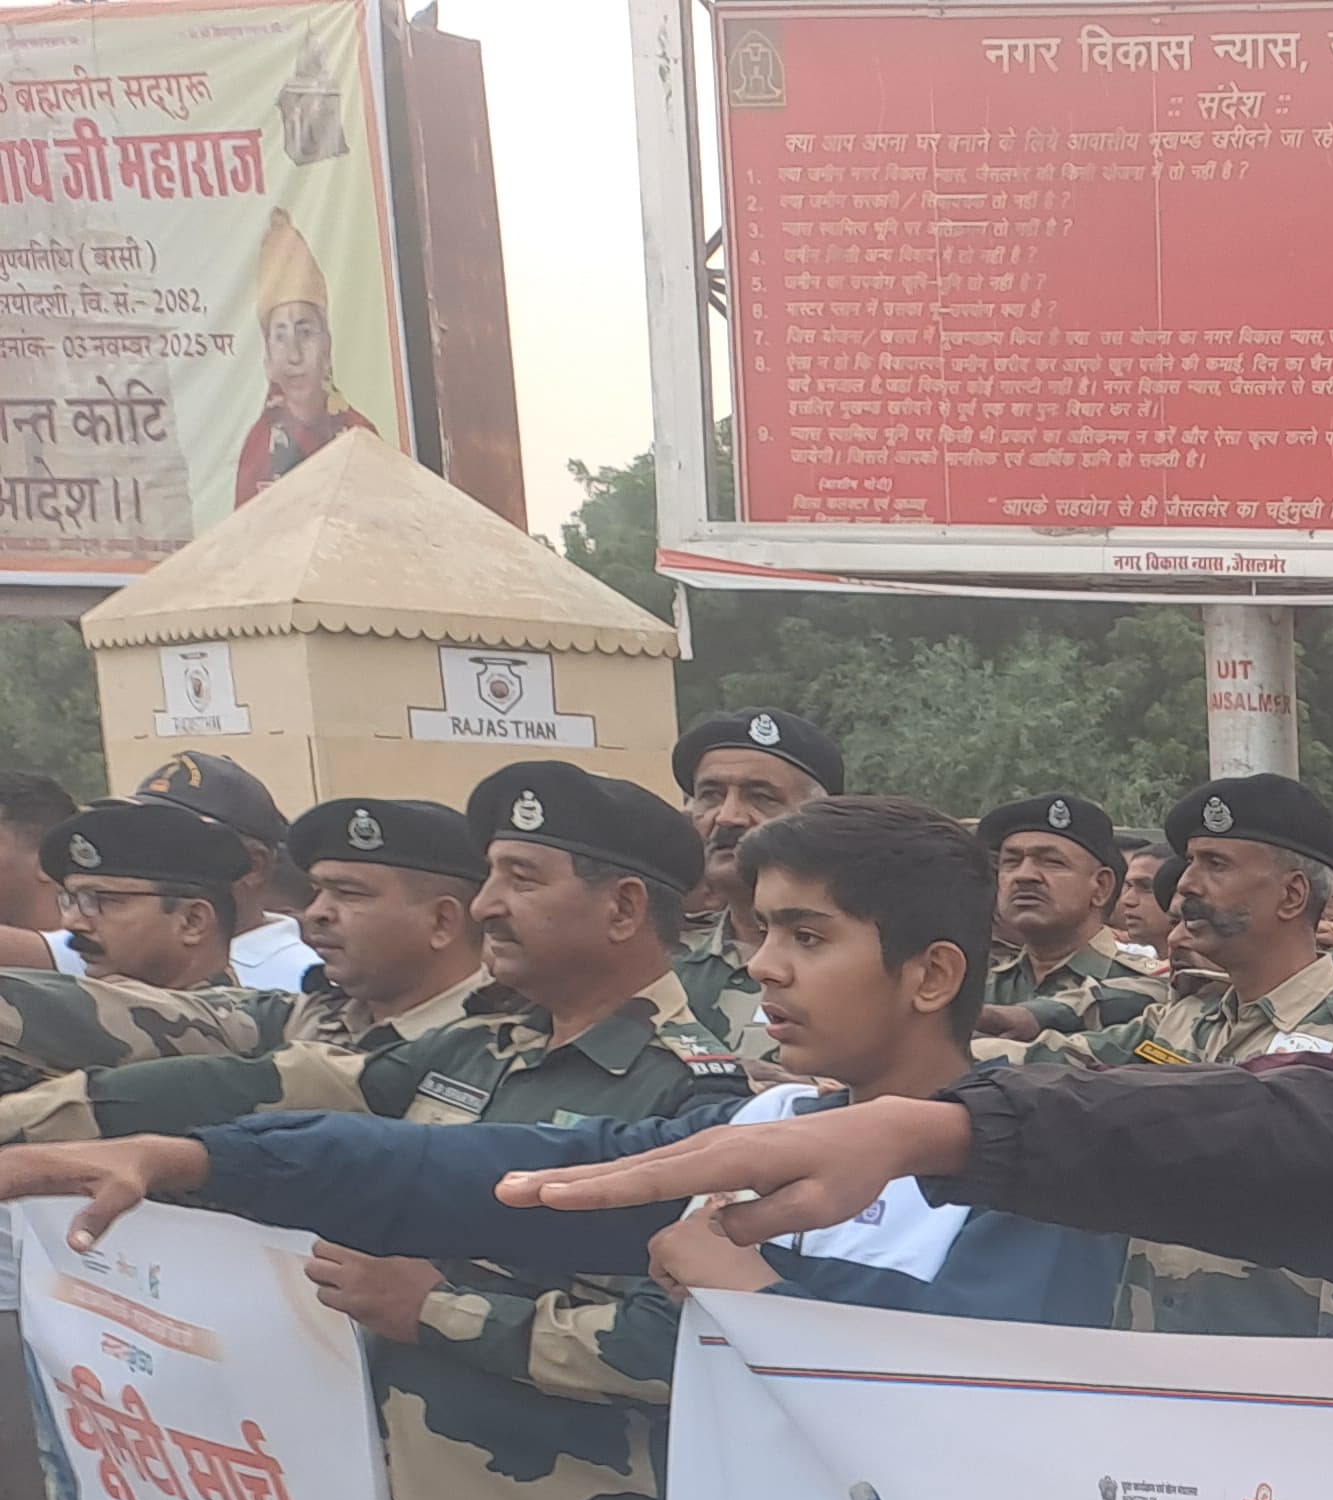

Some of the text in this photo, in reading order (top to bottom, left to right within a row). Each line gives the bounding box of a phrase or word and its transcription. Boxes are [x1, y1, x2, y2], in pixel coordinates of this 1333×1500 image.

[982, 37, 1061, 74] नगर
[1077, 24, 1194, 73] विकास
[1211, 33, 1308, 73] न्यास,
[1197, 81, 1266, 120] संदेश
[785, 133, 816, 152] क्या
[822, 134, 856, 152] आप
[863, 133, 908, 152] अपना
[915, 133, 941, 152] घर
[1212, 123, 1272, 149] खरीदने
[1280, 128, 1302, 147] जा
[53, 117, 112, 201] जी
[112, 128, 265, 200] महाराज
[208, 333, 235, 356] पर
[1204, 330, 1234, 345] नगर
[1239, 325, 1283, 345] विकास
[1252, 352, 1277, 373] दिन
[1230, 376, 1286, 396] जैसलमेर
[64, 376, 167, 445] कोटि
[1056, 493, 1112, 517] सहयोग
[1118, 493, 1134, 517] से
[1140, 495, 1158, 518] ही
[1165, 494, 1231, 518] जैसलमेर
[1236, 500, 1259, 518] का
[1112, 555, 1142, 571] नगर
[1146, 552, 1190, 571] विकास
[1216, 659, 1253, 680] UIT
[449, 715, 558, 740] RAJASTHAN
